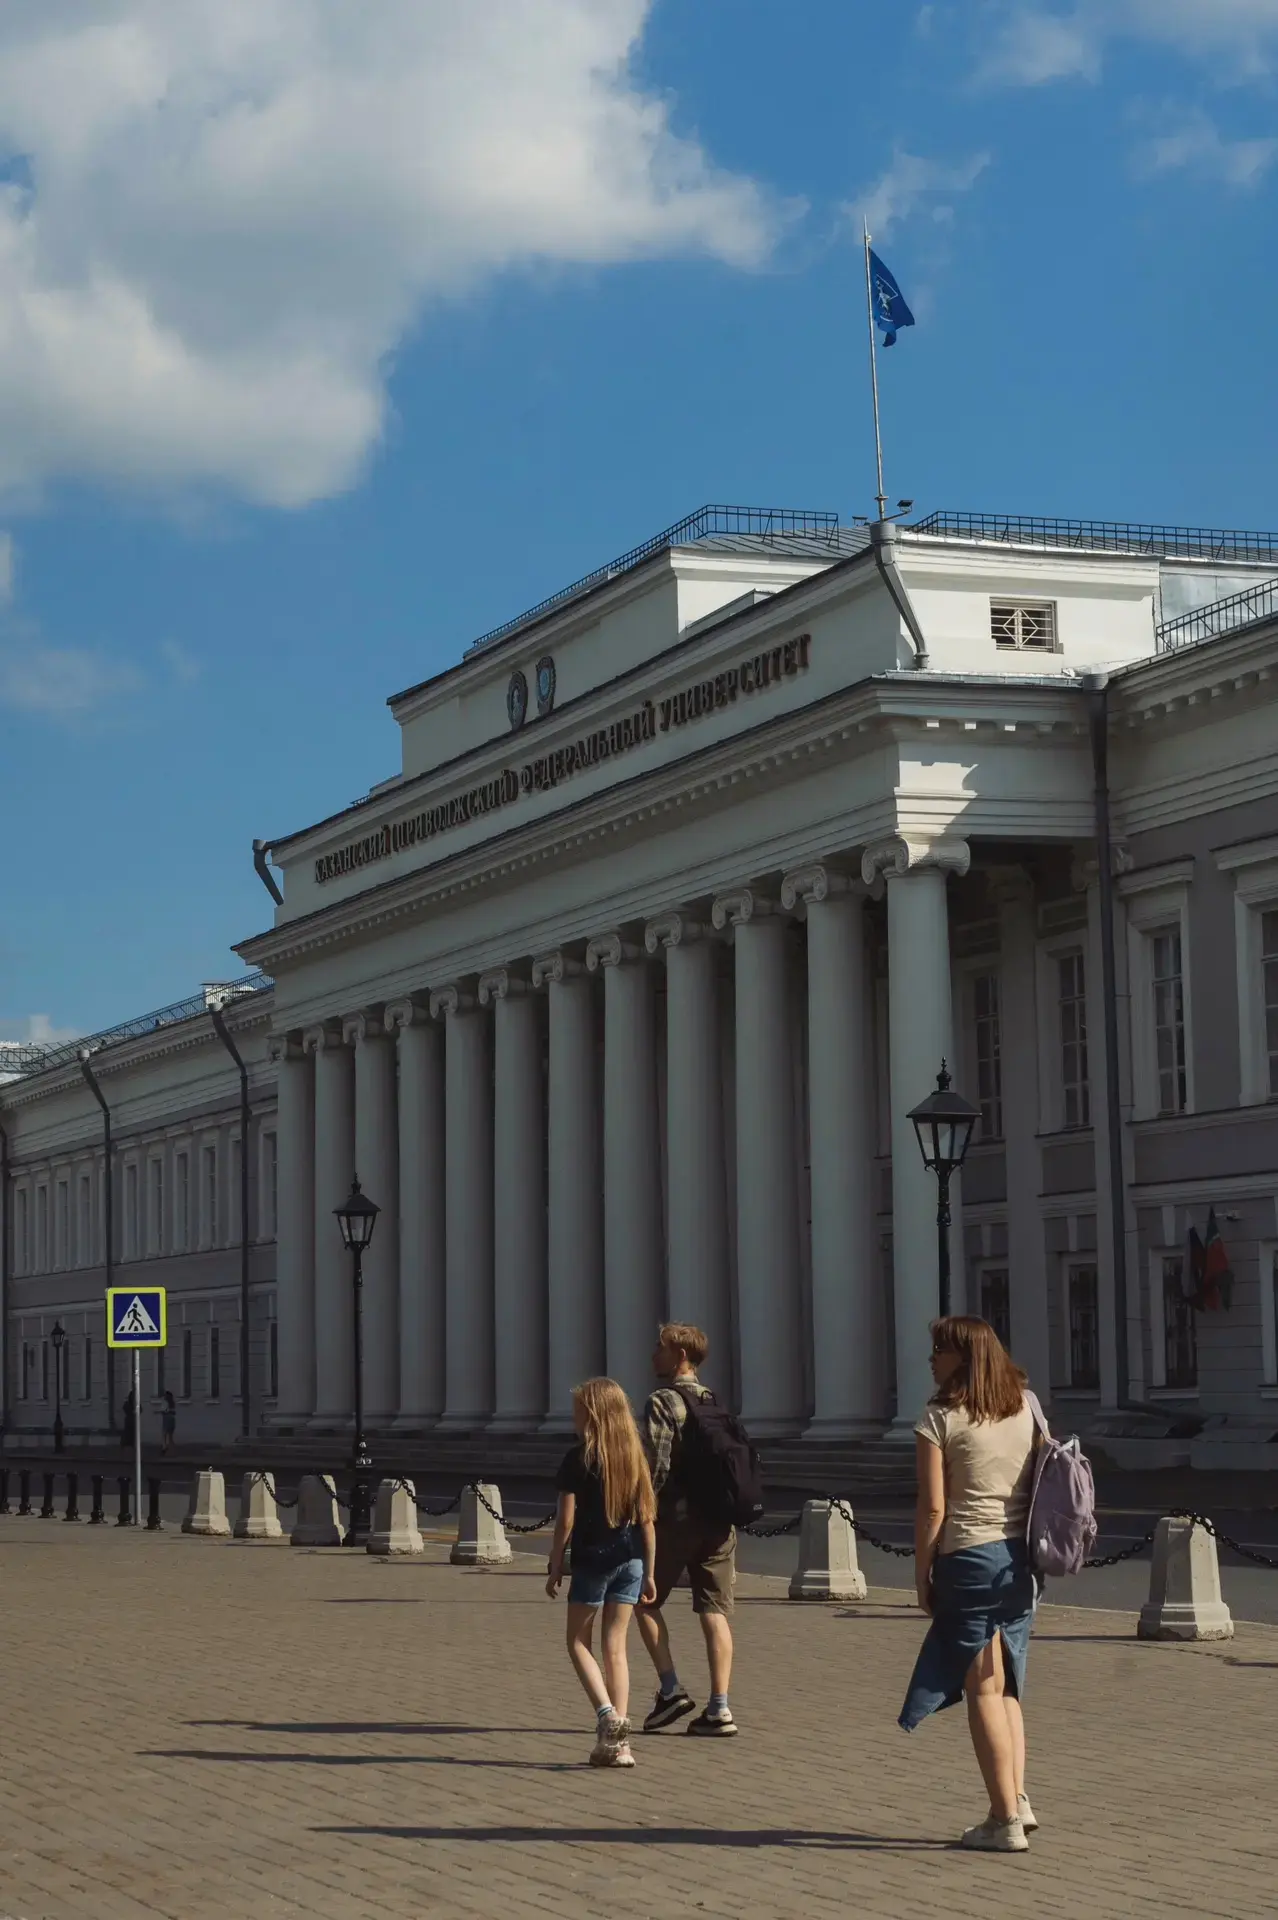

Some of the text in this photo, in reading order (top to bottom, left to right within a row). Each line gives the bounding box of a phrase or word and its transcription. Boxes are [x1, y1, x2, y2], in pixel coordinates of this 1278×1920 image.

[314, 633, 811, 883] КАЗАНСКИЙ (ПРИВОЛЖСКИЙ) ФЕДЕРАЛЬНЫЙ УНИВЕРСИТЕТ
